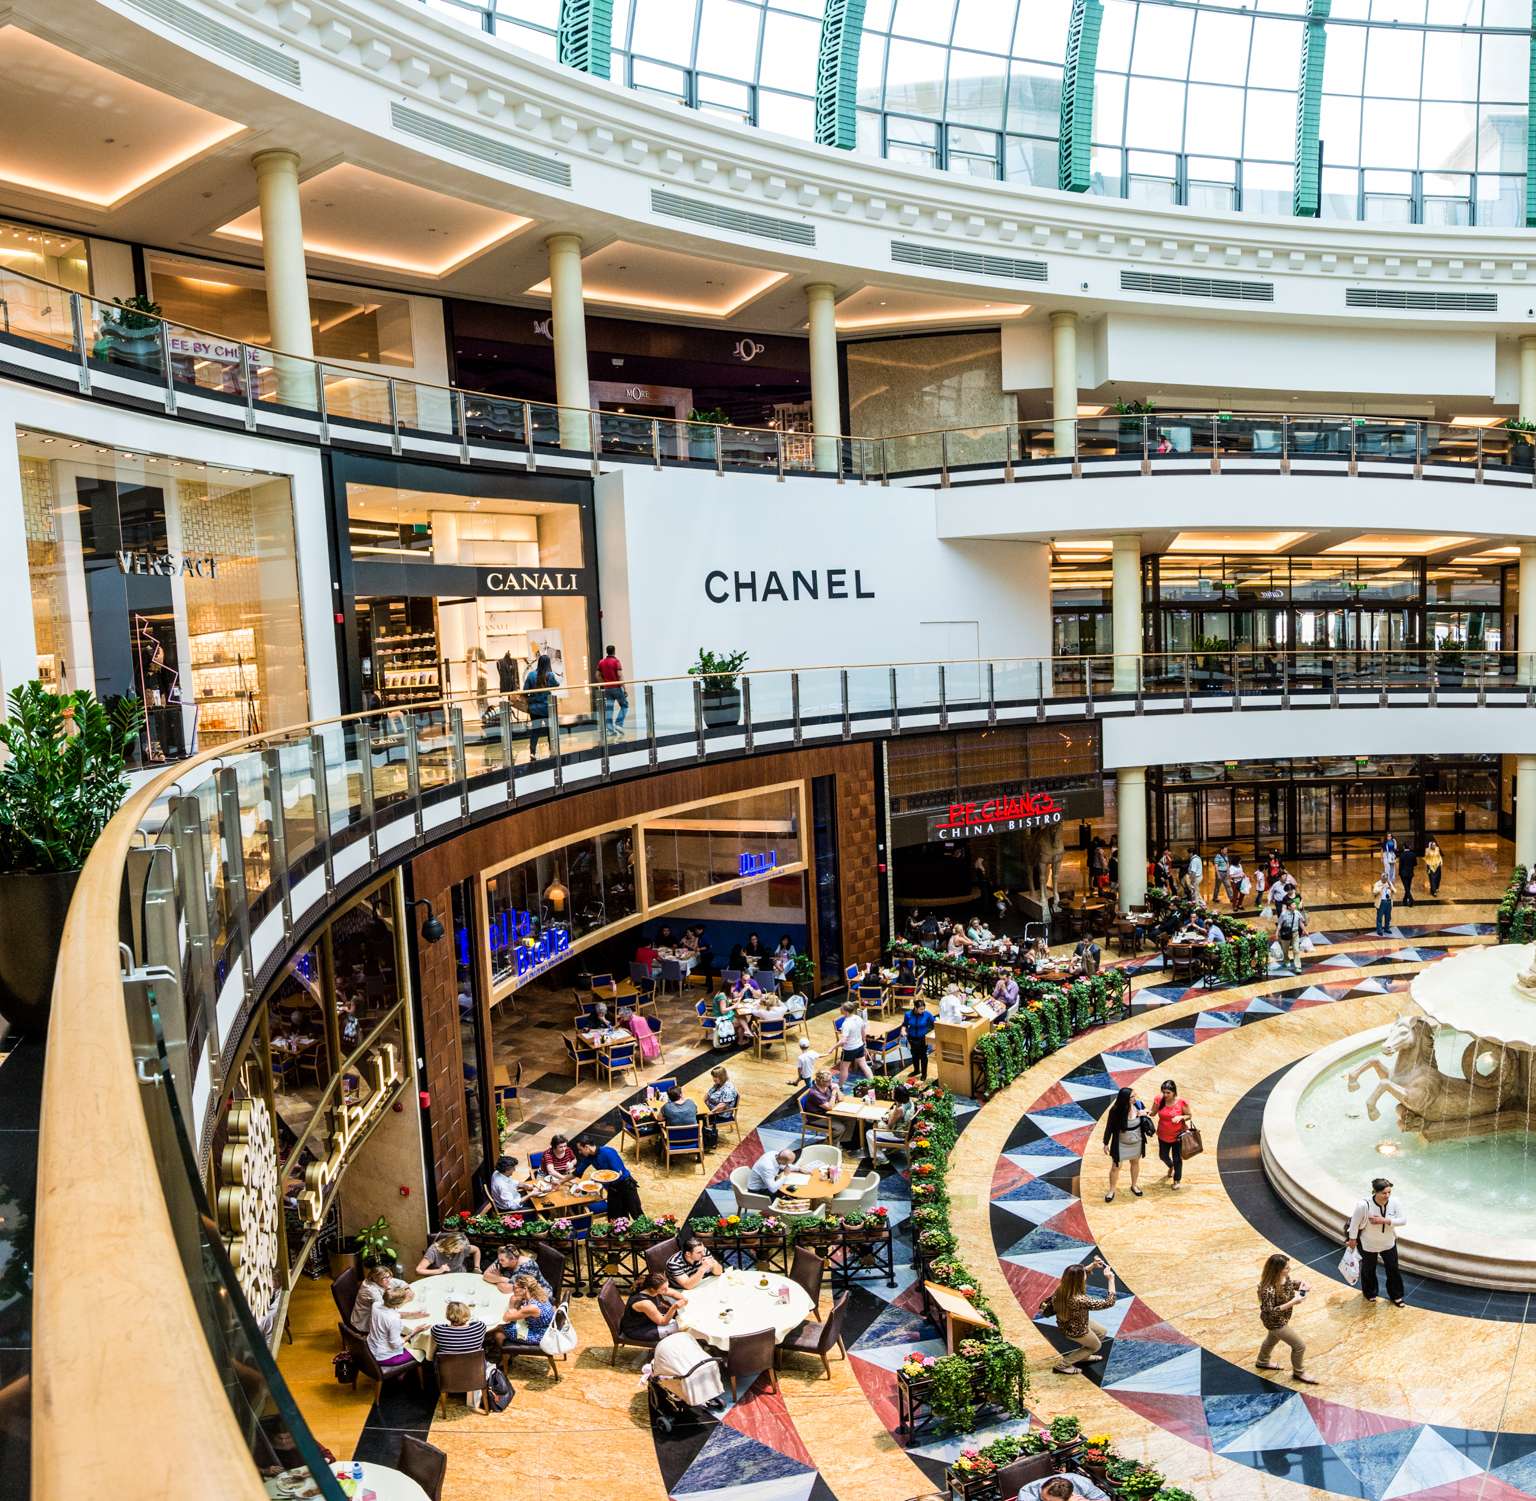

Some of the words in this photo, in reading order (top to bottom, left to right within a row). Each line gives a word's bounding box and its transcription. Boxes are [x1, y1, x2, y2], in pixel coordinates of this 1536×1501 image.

[168, 338, 190, 352] EE
[192, 342, 211, 354] BY
[486, 572, 579, 592] CANALI
[704, 569, 876, 604] CHANEL
[939, 823, 995, 840] CHINA
[1008, 812, 1061, 831] BISTRO
